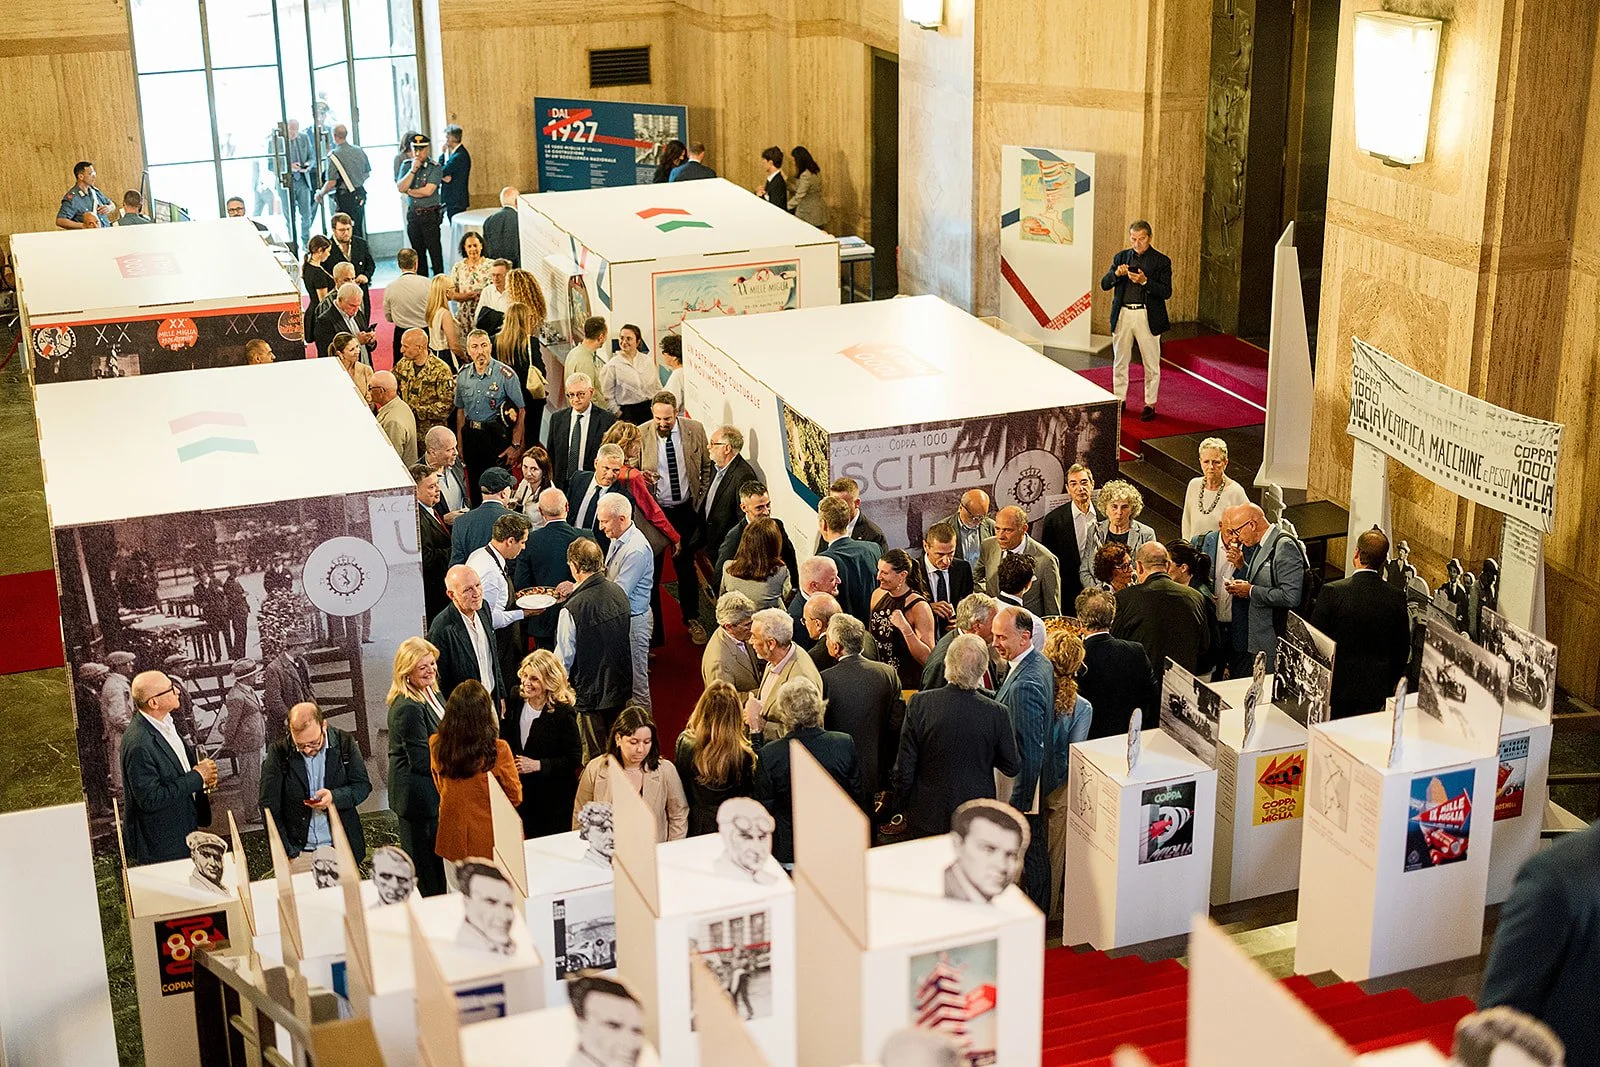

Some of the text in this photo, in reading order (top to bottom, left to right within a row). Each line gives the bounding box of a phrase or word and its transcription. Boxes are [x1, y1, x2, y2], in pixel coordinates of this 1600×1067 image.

[552, 108, 570, 119] DAL
[548, 119, 598, 143] 1927
[750, 285, 767, 294] MILLE
[768, 282, 790, 292] MIGLIA
[176, 328, 196, 336] MIGLIA
[694, 362, 726, 395] MOVIMENTO
[695, 349, 728, 382] PATRIMONIO
[729, 376, 760, 409] CULTURALE
[1353, 364, 1382, 394] COPPA
[1354, 380, 1379, 406] 1000
[923, 432, 948, 446] 1000
[1382, 402, 1426, 455] VERIFICA
[1429, 433, 1484, 481] MACCHINE
[1489, 466, 1510, 488] PESO
[1514, 444, 1553, 465] COPPA
[830, 446, 987, 495] SCITA
[1518, 460, 1551, 482] 1000
[1510, 472, 1554, 508] MIGLIA
[1503, 744, 1527, 754] MIGLIA
[1154, 790, 1182, 803] COPPA
[1262, 798, 1296, 809] COPPA
[1440, 796, 1466, 813] MILLE
[1262, 812, 1294, 823] MIGLIA
[1266, 804, 1296, 816] 1000
[1429, 808, 1464, 822] IX MIGLIA
[1147, 842, 1193, 862] MIGLIA
[162, 981, 193, 992] COPPA
